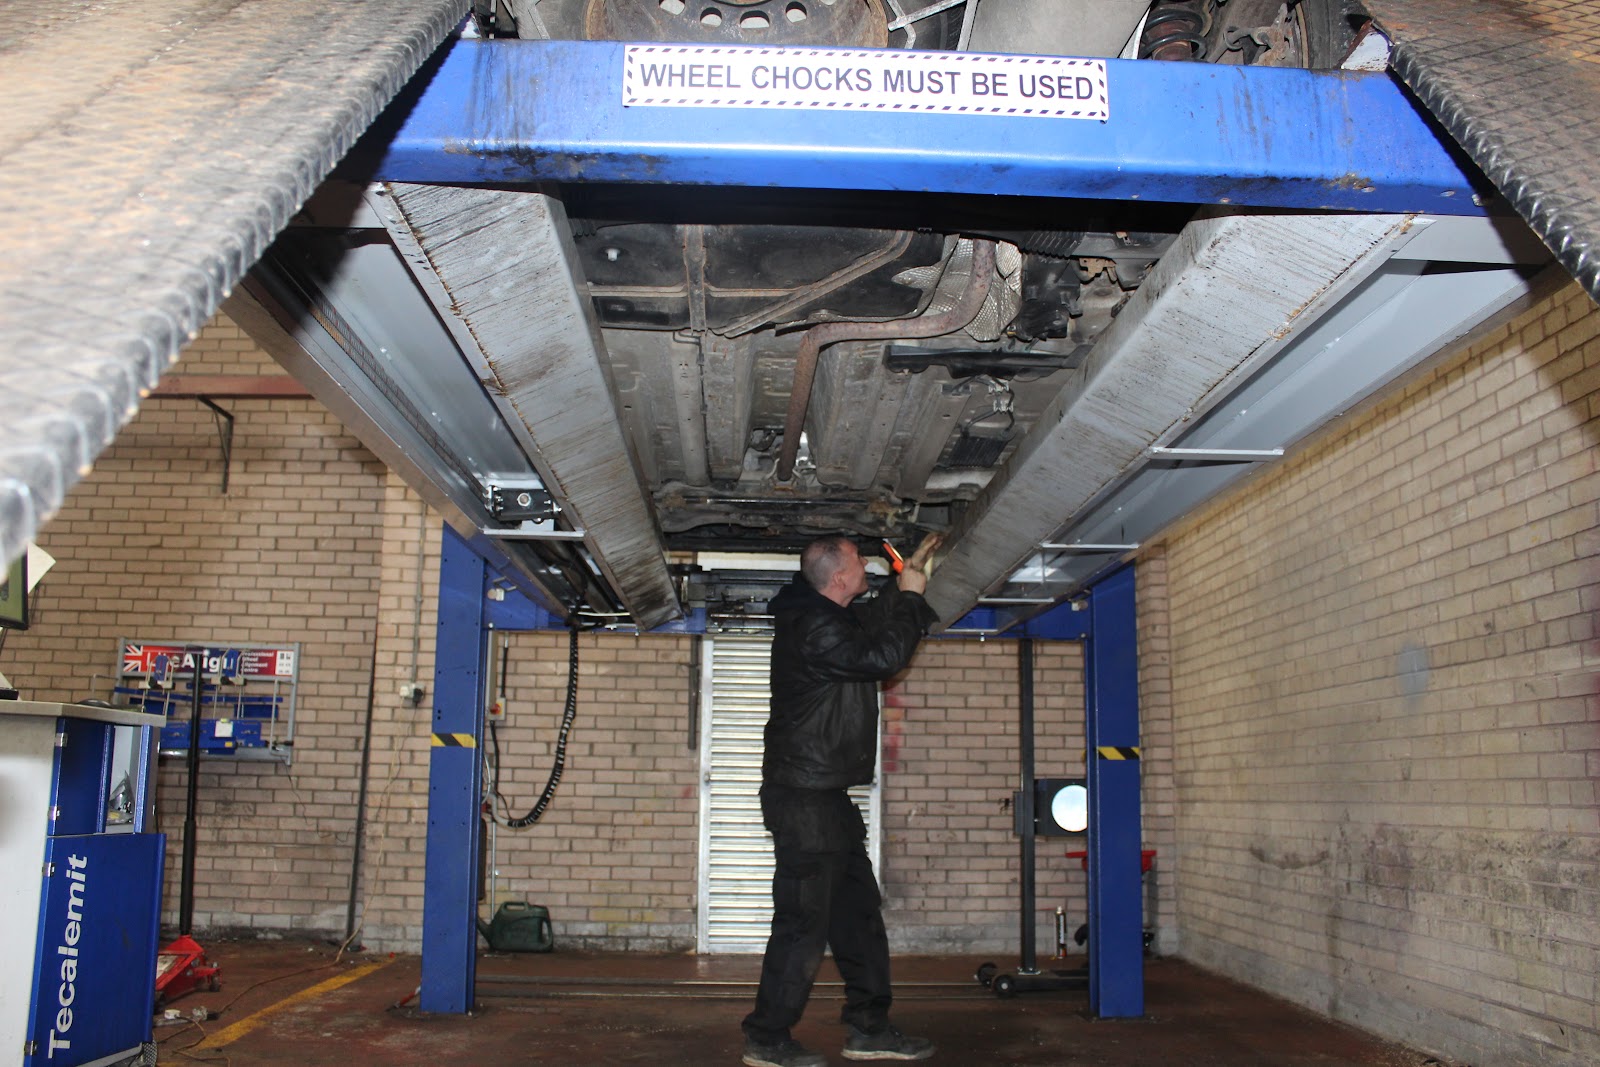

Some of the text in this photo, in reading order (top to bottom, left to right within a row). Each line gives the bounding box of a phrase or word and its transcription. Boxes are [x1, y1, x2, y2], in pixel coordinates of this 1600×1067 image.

[640, 64, 1093, 100] WHEEL CHOCKS MUST BE USED
[48, 854, 88, 1058] Tecalemit
